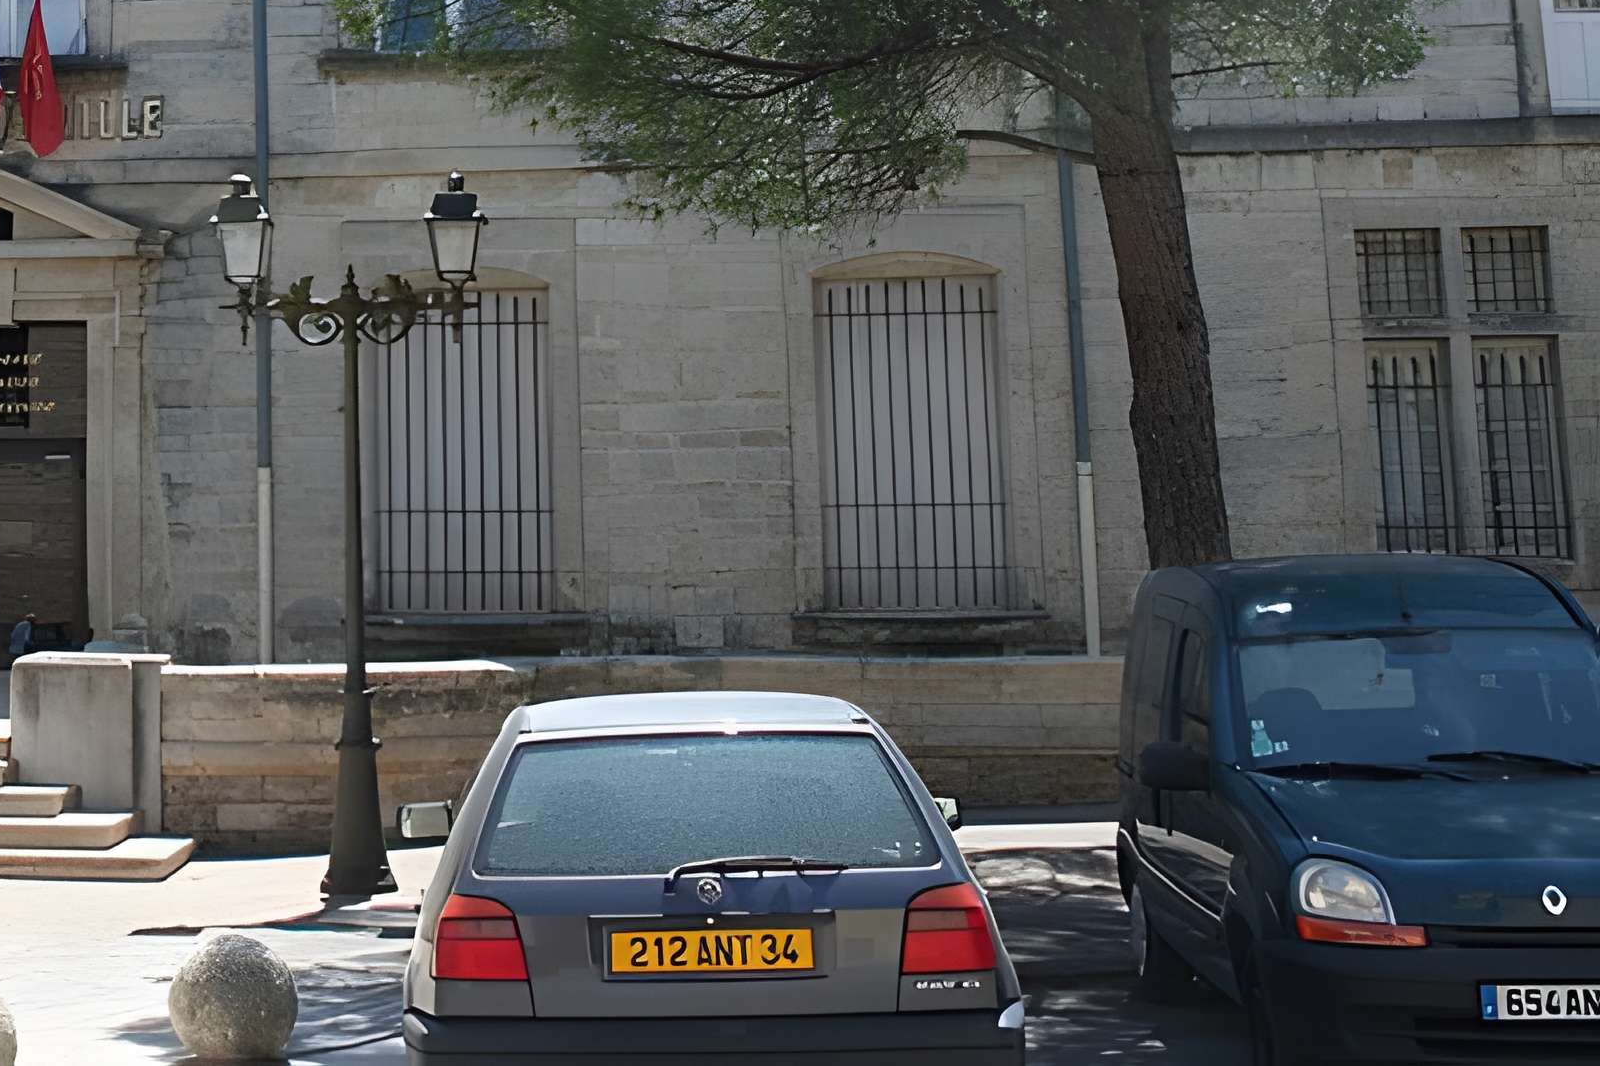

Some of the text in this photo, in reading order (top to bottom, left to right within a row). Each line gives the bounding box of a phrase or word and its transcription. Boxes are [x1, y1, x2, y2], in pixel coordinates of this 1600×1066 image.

[629, 933, 799, 967] 212 ANT 34
